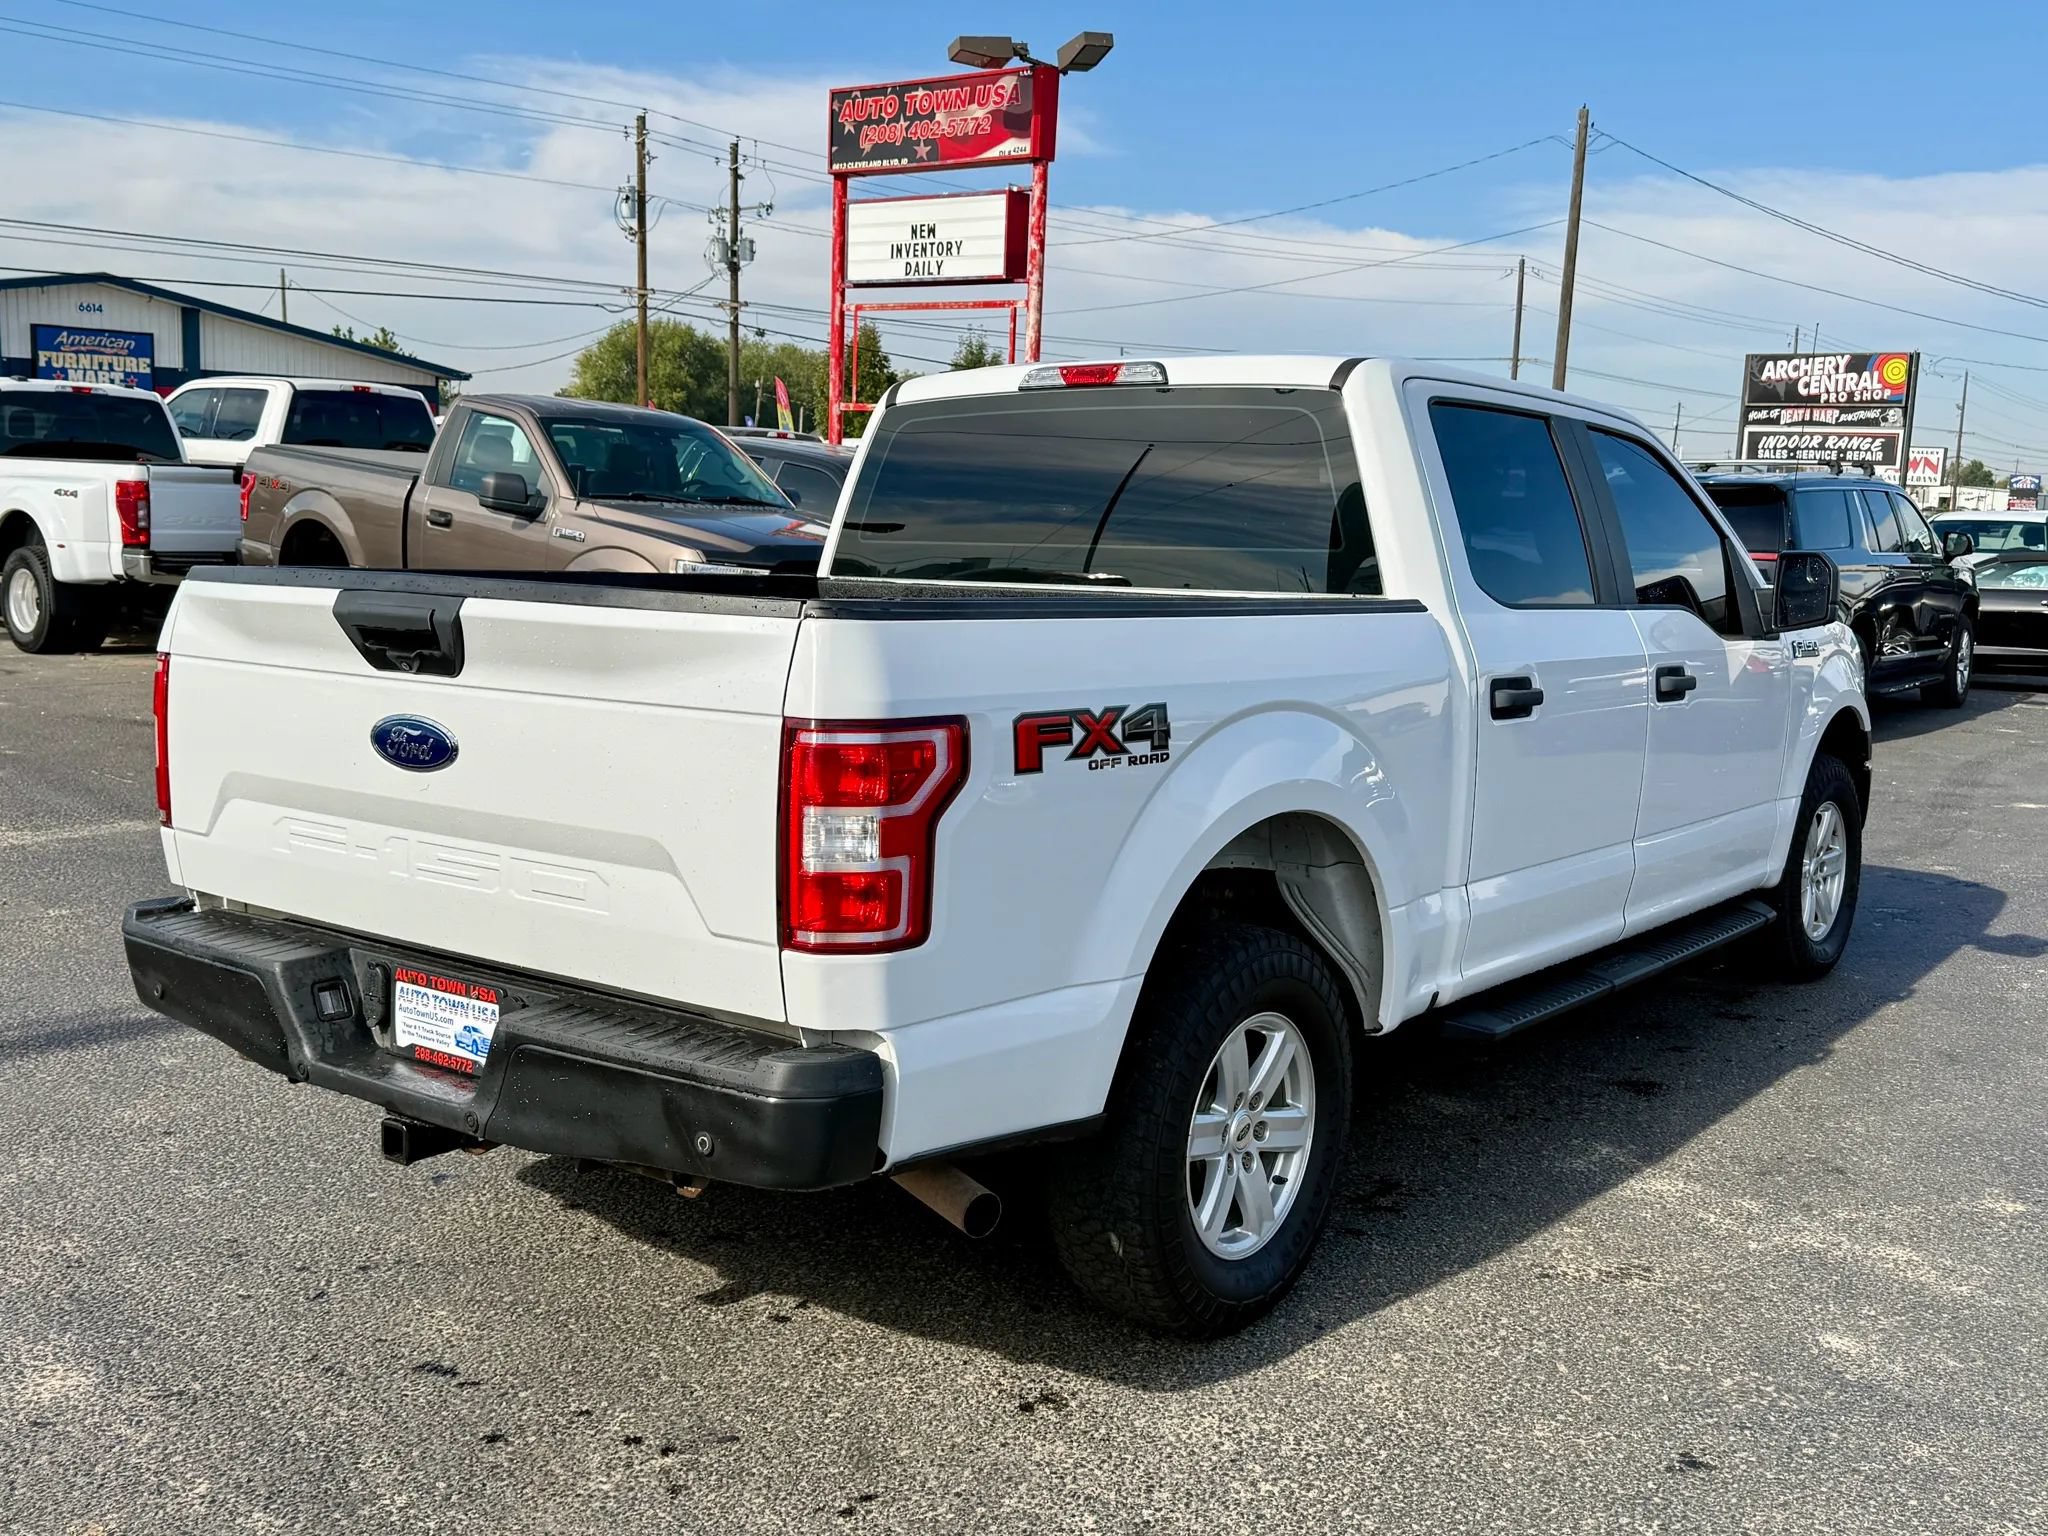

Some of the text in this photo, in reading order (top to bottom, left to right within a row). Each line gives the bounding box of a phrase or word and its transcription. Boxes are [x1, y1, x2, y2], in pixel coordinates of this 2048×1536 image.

[839, 82, 1021, 122] AUTO TOWN USA
[860, 115, 991, 146] (208) 402-5772
[847, 161, 881, 169] CLEVELAND
[911, 223, 936, 239] NEW
[890, 240, 963, 259] INVENTORY
[905, 259, 944, 277] DAILY
[78, 303, 103, 313] 6614
[54, 331, 135, 350] American
[38, 350, 151, 374] FURNITURE
[1761, 355, 1852, 382] ARCHERY
[68, 369, 125, 385] MART
[1797, 370, 1883, 397] CENTRAL
[1820, 389, 1892, 403] PRO SHOP
[1748, 407, 1882, 425] HOME OF DEATH HARP BOWSTRINGS
[1757, 434, 1886, 451] INDOOR RANGE
[1757, 449, 1884, 461] SALES SERVICE REPAIR
[386, 725, 433, 761] Ford
[1012, 702, 1171, 776] FX4
[1088, 752, 1169, 770] OFF ROAD
[395, 967, 497, 1002] AUTO TOWN USA
[398, 985, 498, 1024] AUTO TOWN USA
[398, 1003, 454, 1026] AutoTownUS.com
[415, 1047, 474, 1073] 208-402-5772
